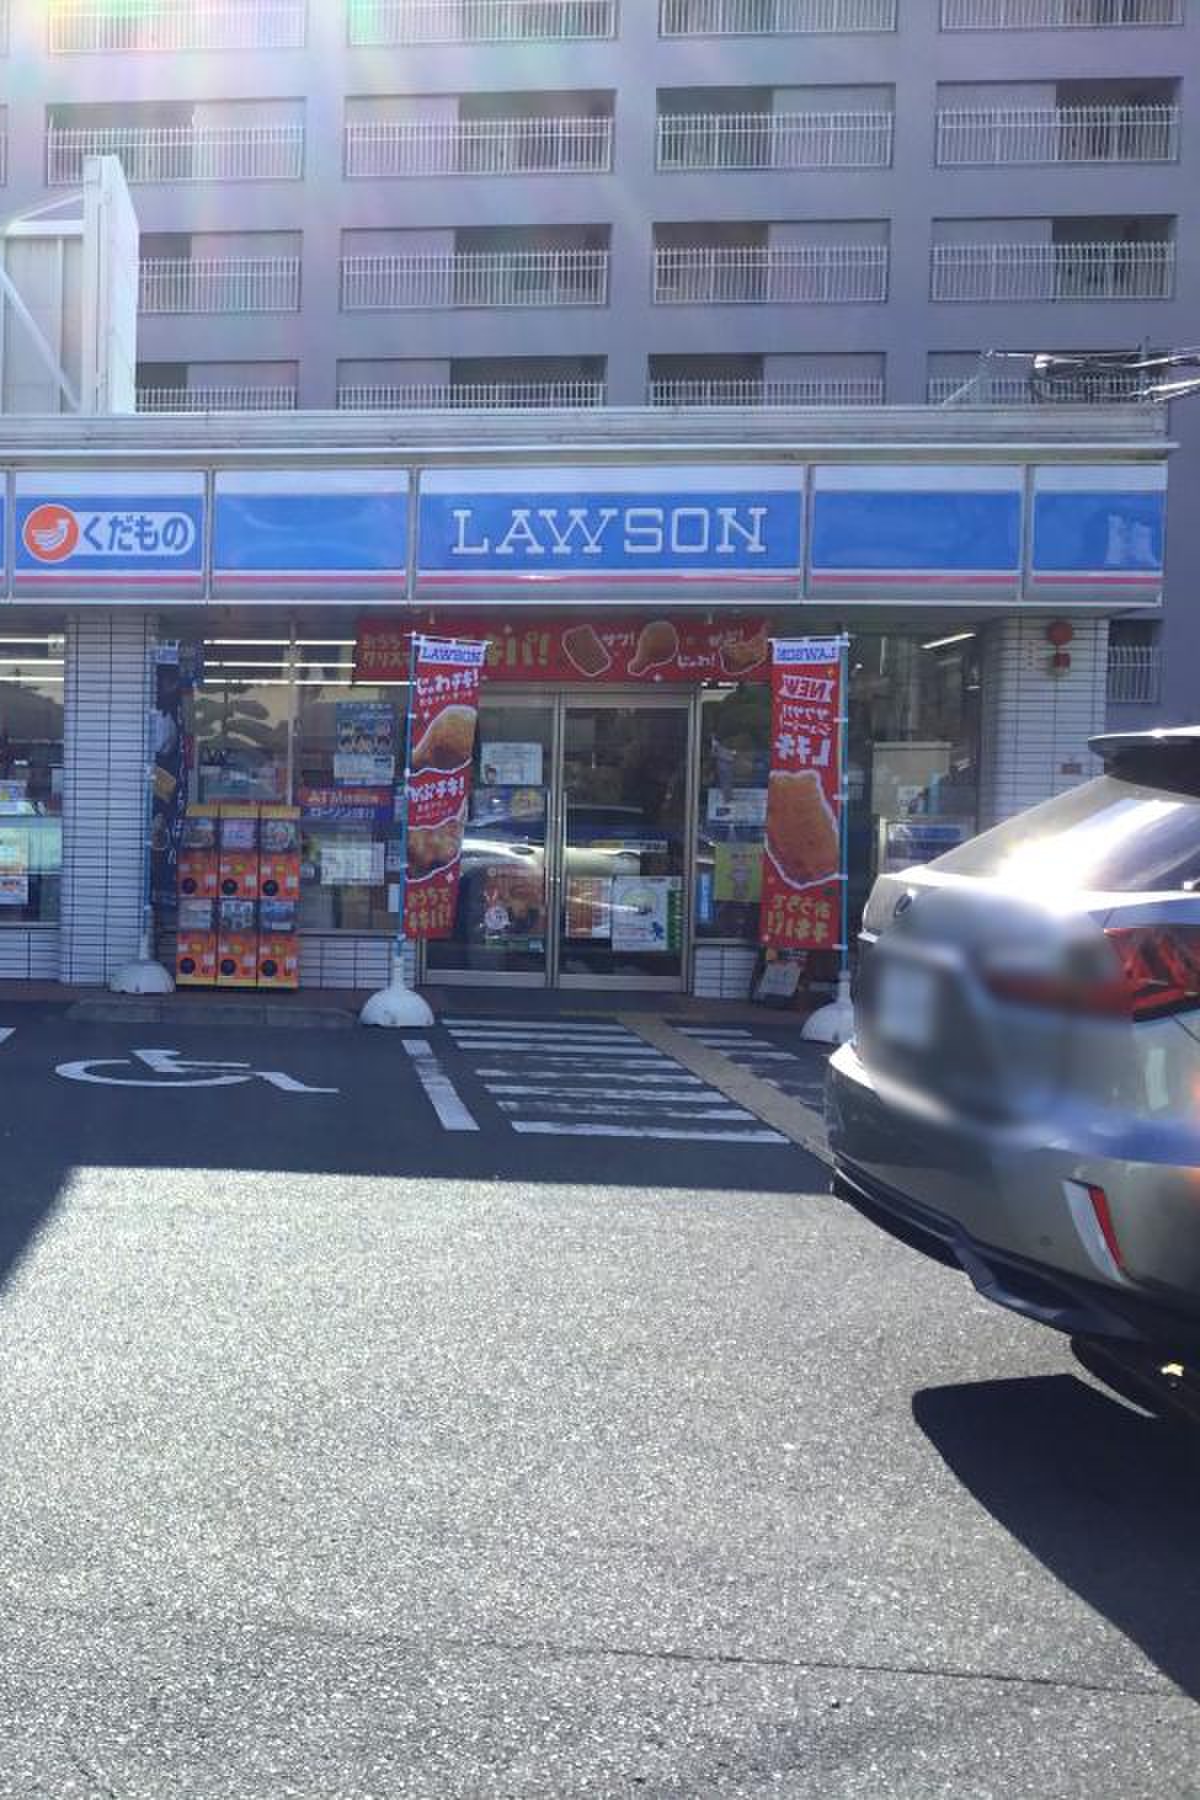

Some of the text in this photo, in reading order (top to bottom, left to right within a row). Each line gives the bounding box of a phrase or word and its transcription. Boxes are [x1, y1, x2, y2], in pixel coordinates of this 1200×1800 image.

[83, 515, 189, 551] くだもの
[452, 508, 768, 555] LAWSON
[421, 646, 482, 663] LAWSON
